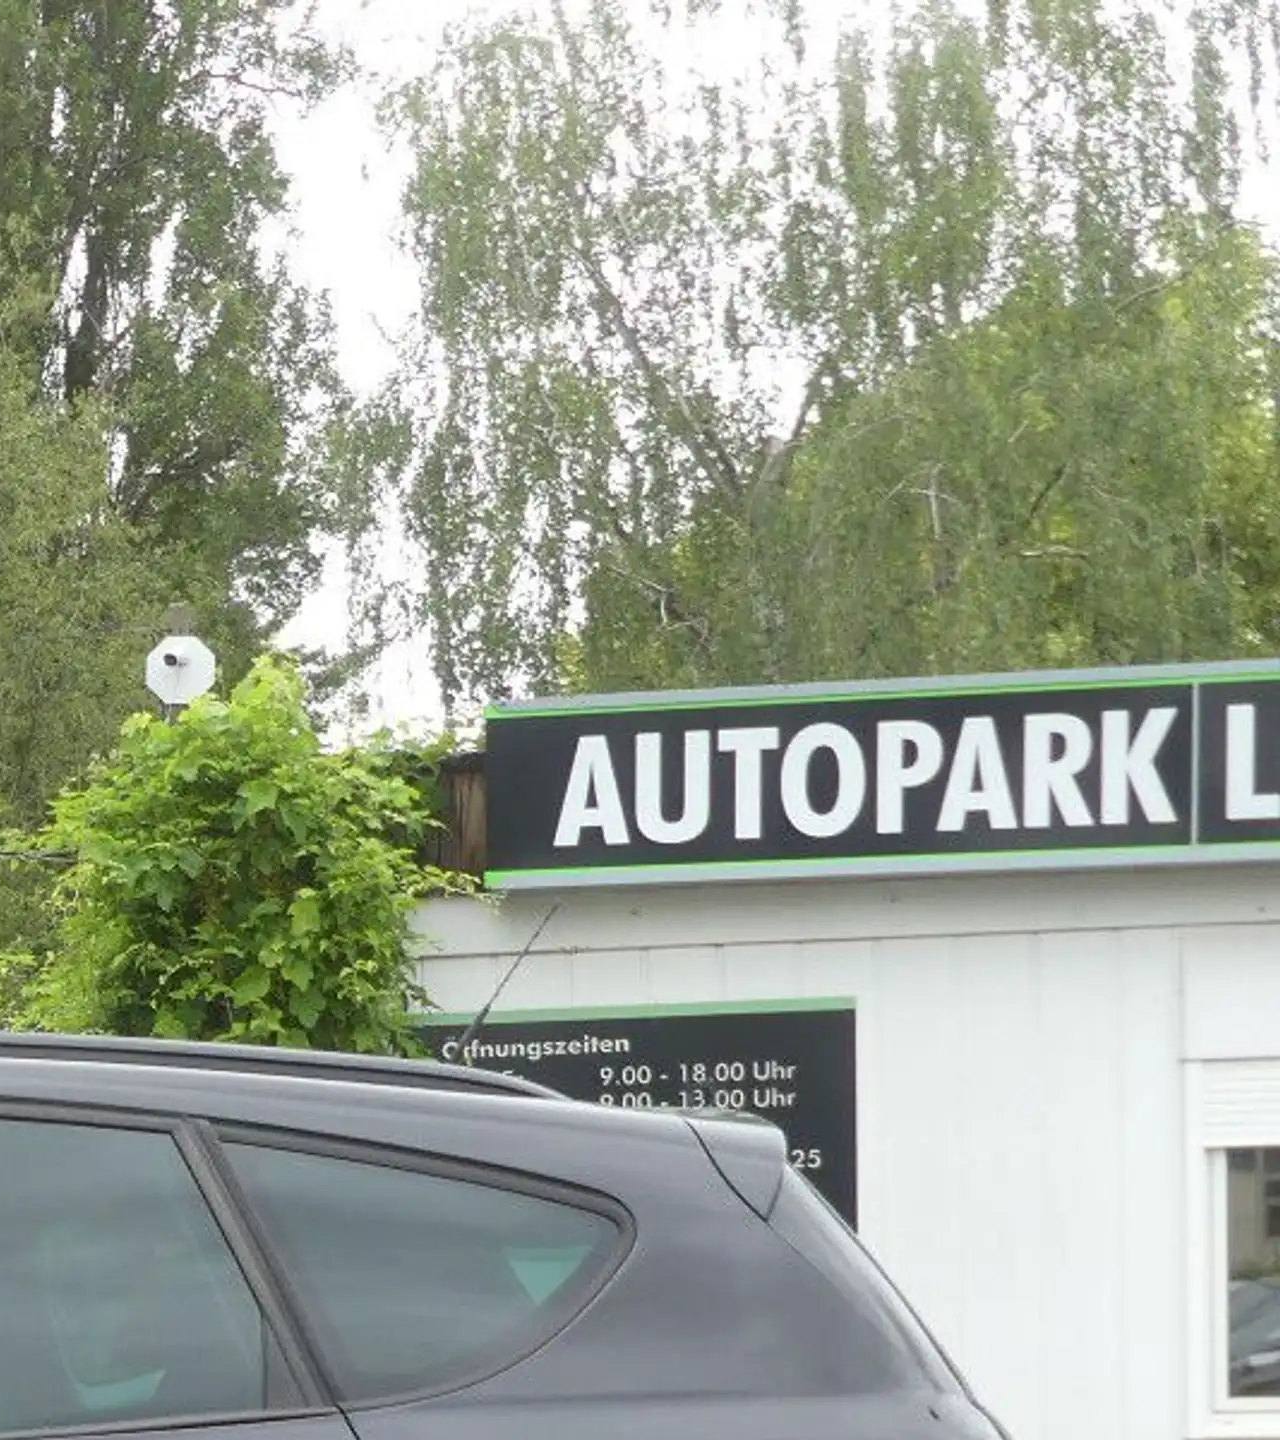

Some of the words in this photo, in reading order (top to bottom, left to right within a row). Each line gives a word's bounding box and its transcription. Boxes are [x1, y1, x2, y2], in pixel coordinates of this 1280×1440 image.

[553, 706, 1179, 847] AUTOPARK
[600, 1065, 652, 1086] 9.00
[680, 1062, 744, 1083] 18.00
[753, 1060, 797, 1080] Uhr
[600, 1092, 651, 1108] 900
[753, 1087, 797, 1108] Uhr
